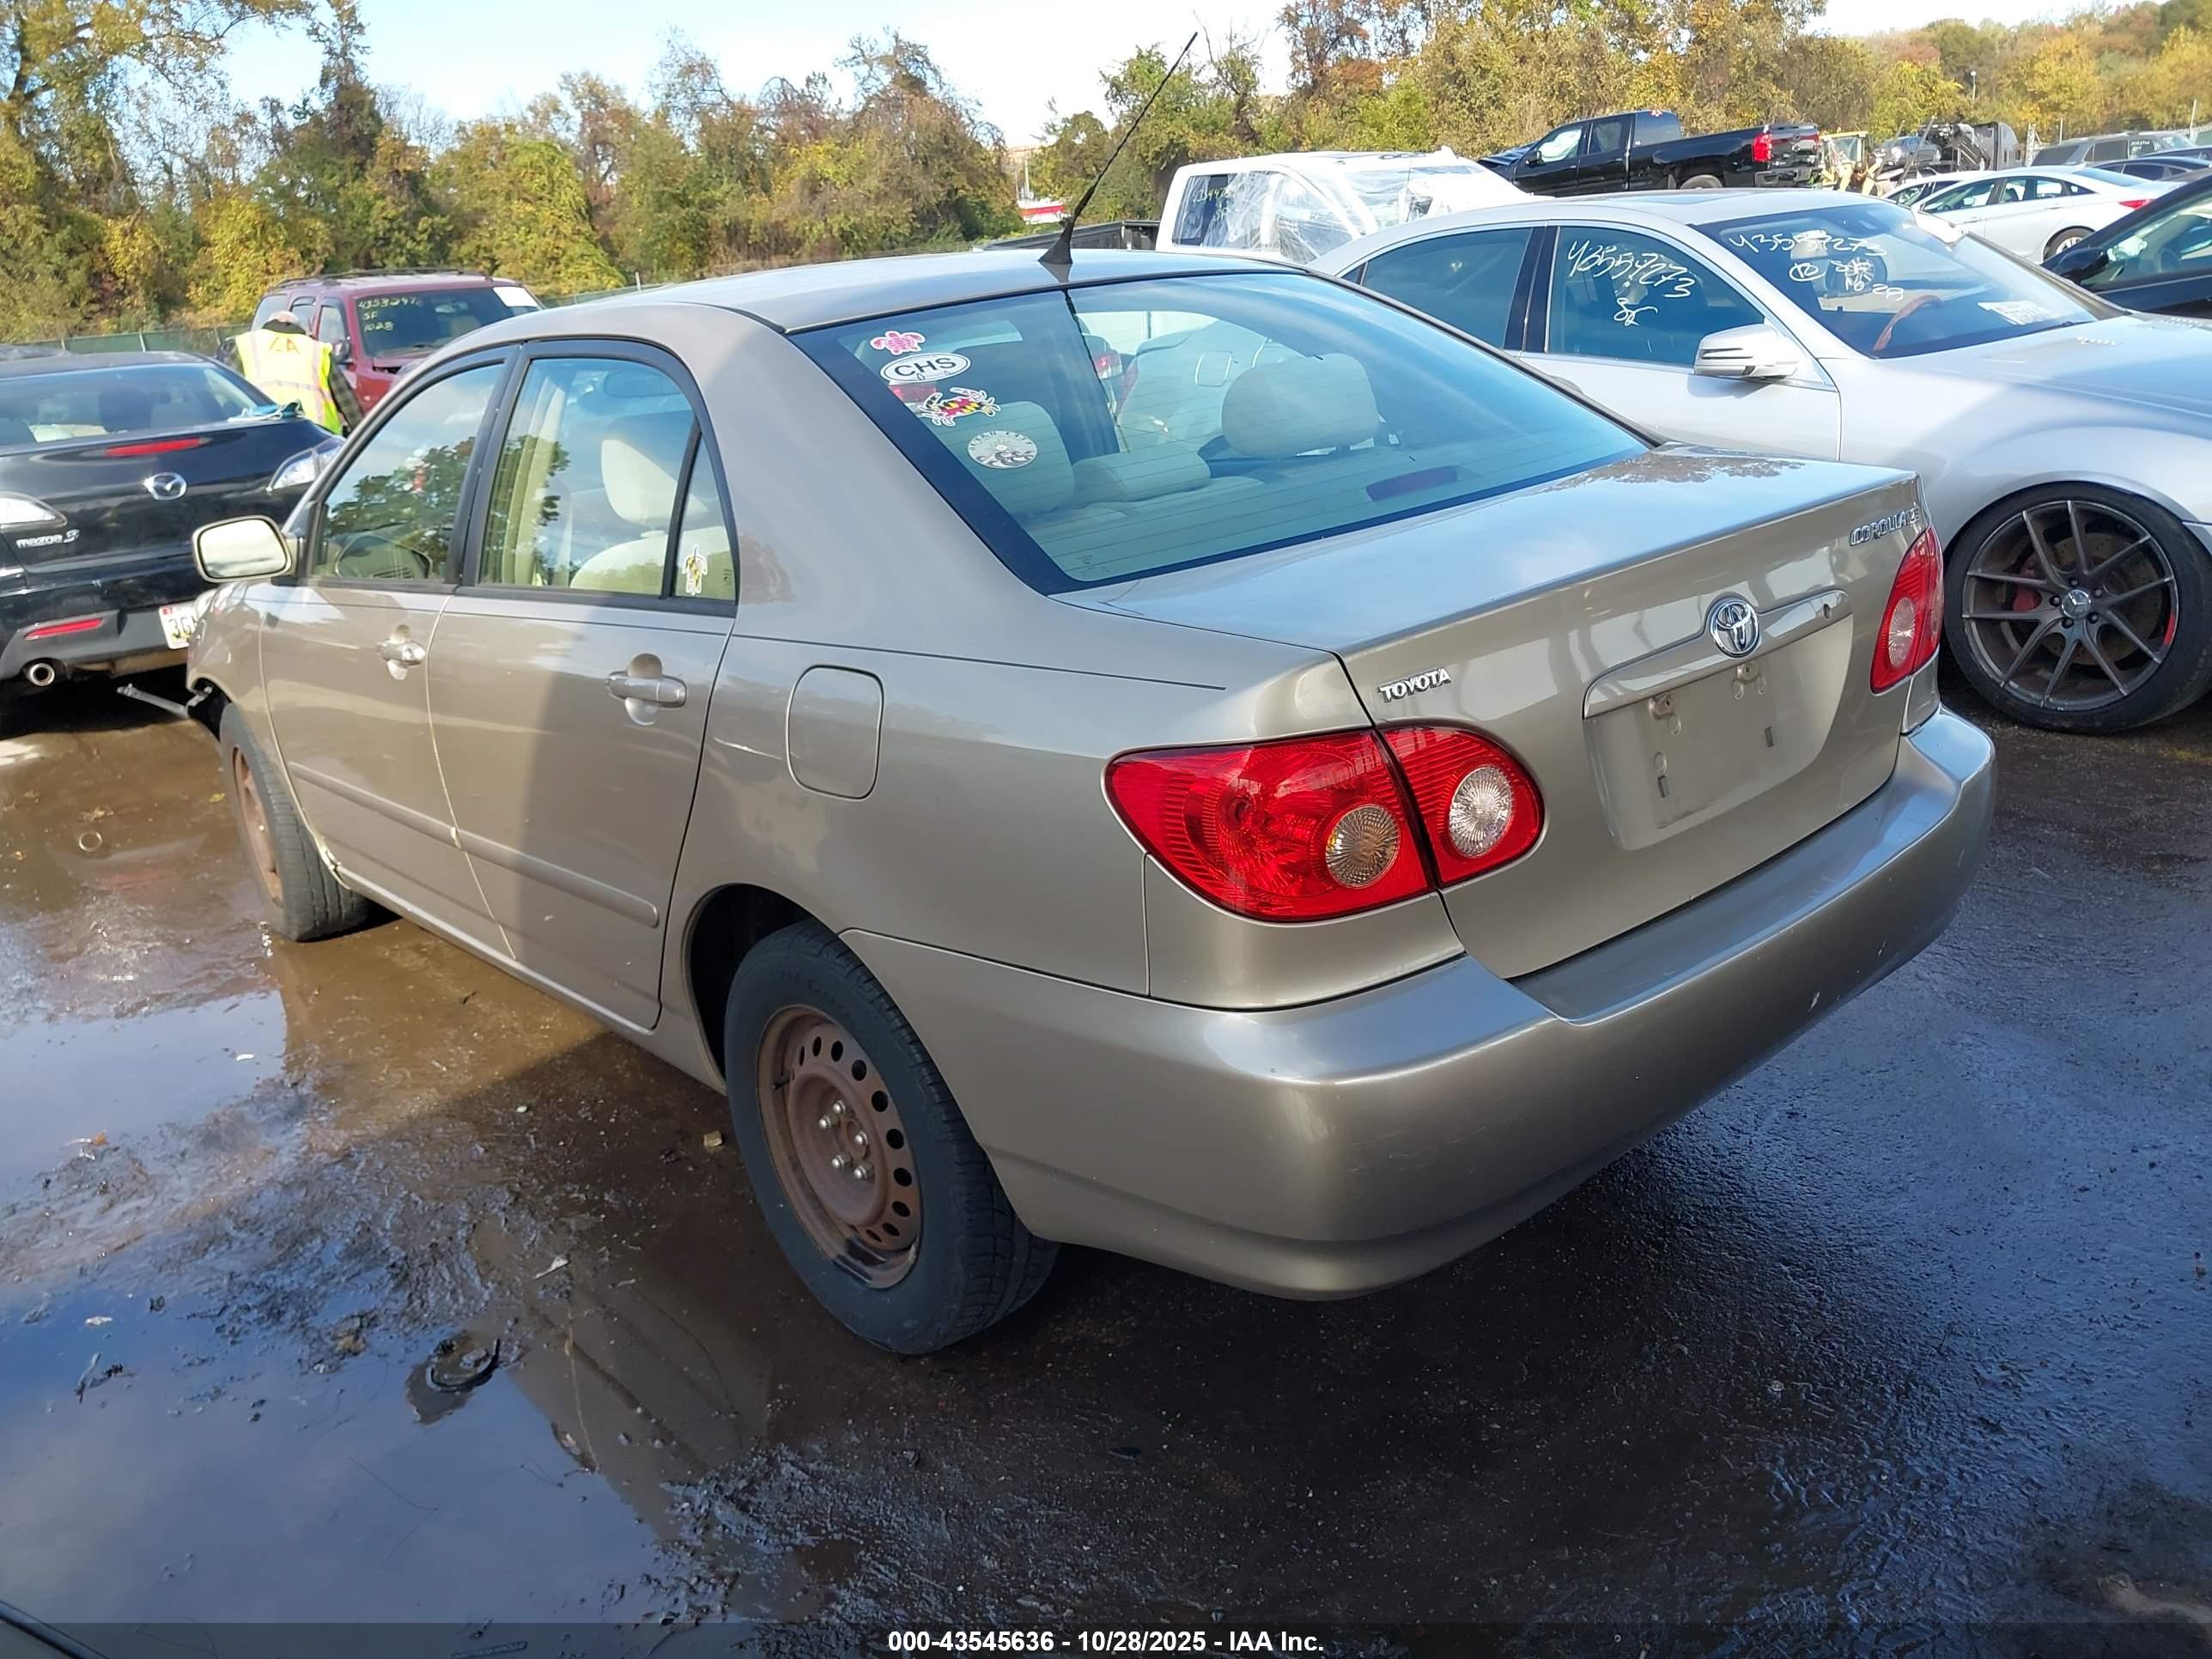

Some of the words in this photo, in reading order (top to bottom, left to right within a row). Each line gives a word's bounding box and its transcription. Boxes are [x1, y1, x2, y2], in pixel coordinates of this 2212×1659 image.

[894, 356, 957, 377] CHS
[1850, 510, 1907, 546] COROLLA
[1377, 667, 1451, 703] TOYOTA
